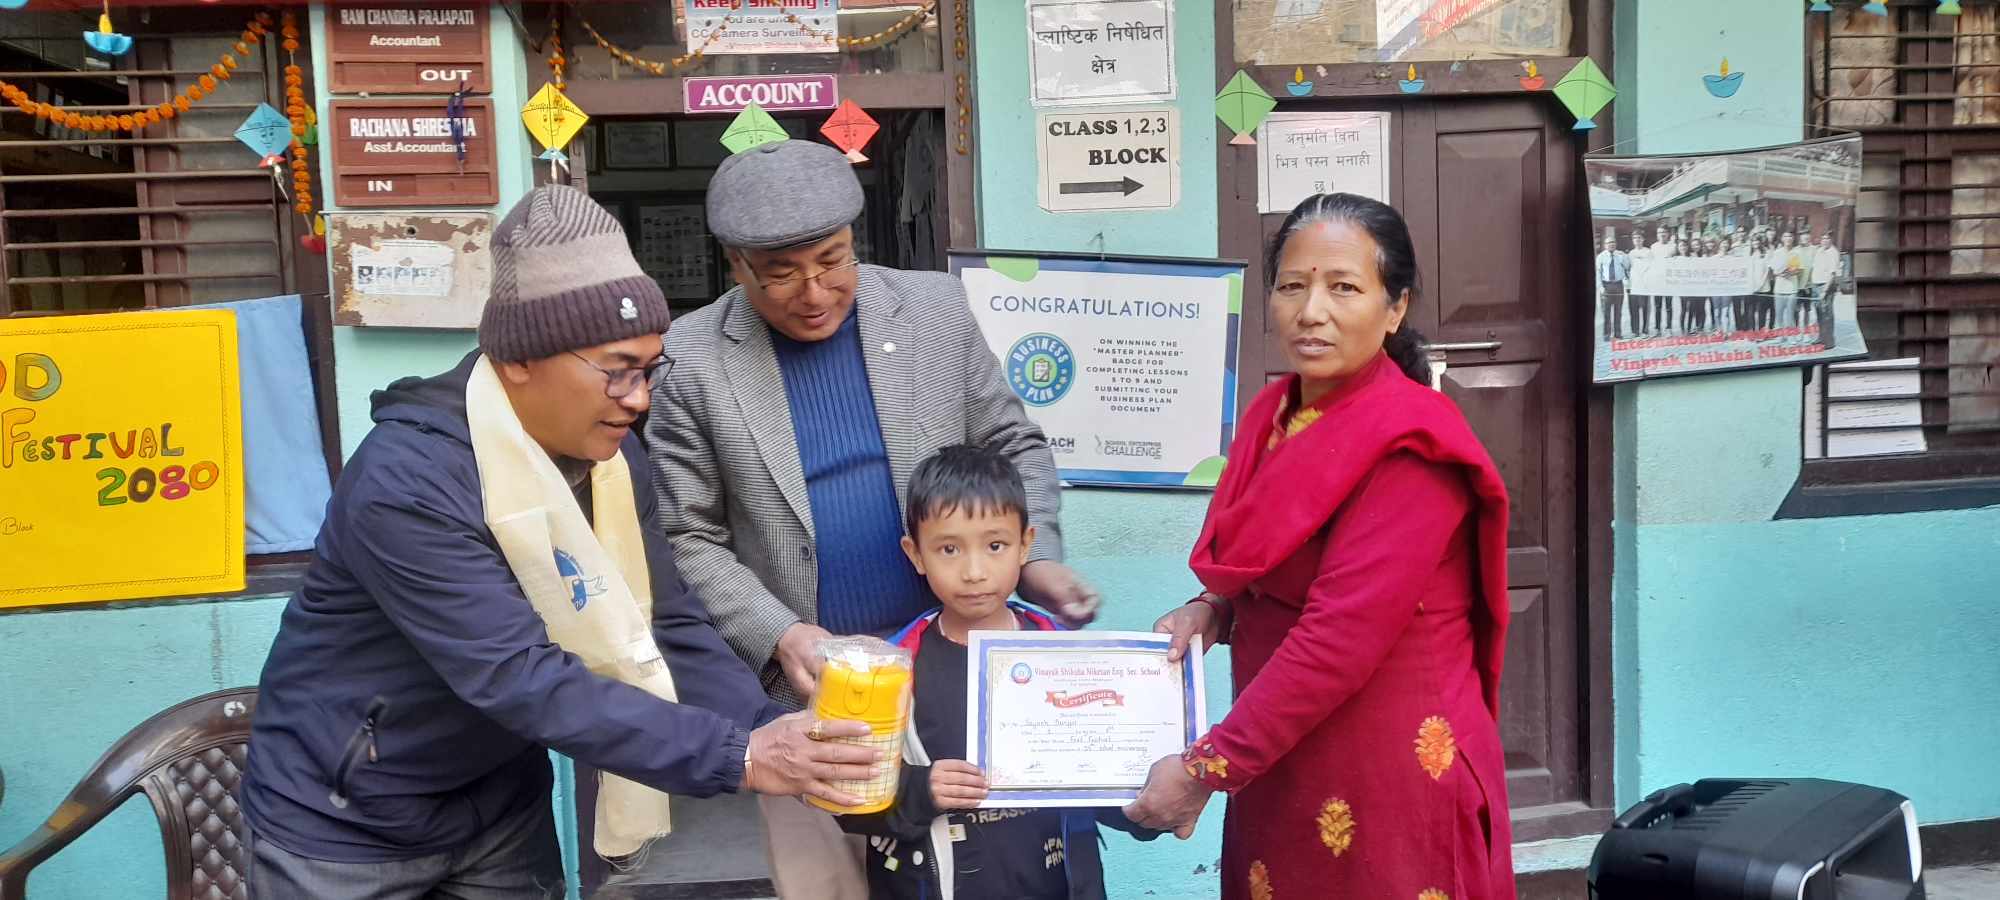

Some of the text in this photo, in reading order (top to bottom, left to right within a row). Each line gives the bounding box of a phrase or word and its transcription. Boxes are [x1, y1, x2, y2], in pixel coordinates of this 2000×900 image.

[341, 9, 474, 25] RAM CHANDRA PRAJAPATI
[370, 35, 441, 46] Accountant
[420, 69, 472, 81] OUT
[700, 81, 823, 106] ACCOUNT
[350, 117, 410, 137] RACHANA
[1048, 118, 1167, 136] CLASS 1,2,3
[1088, 148, 1167, 165] BLOCK
[368, 180, 392, 192] IN
[990, 295, 1200, 319] CONGRATULATIONS!
[1116, 339, 1157, 347] WINNING
[1160, 340, 1178, 348] THE
[1012, 337, 1069, 364] BUSINESS
[1086, 366, 1189, 377] COMPLETING LESSONS
[1025, 387, 1055, 401] PLAN
[1094, 385, 1179, 395] SUBMITTING YOUR
[1100, 395, 1145, 403] BUSINESS
[1110, 405, 1161, 413] DOCUMENT
[1104, 445, 1162, 457] CHALLENGE
[96, 461, 219, 506] 2080
